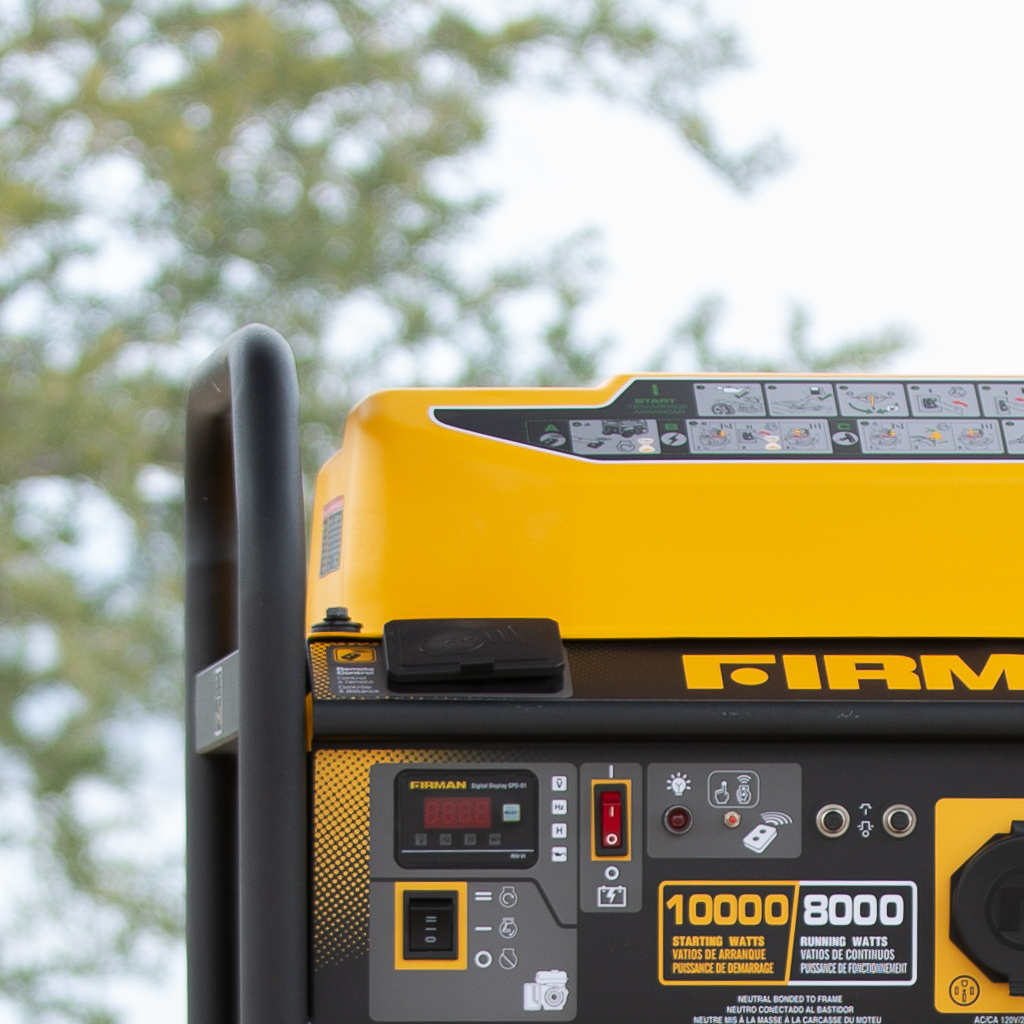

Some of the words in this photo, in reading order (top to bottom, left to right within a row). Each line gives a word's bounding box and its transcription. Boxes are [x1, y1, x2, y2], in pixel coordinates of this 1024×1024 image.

[410, 781, 466, 789] FIRMAN
[556, 826, 563, 834] H
[666, 893, 789, 925] 10000
[804, 893, 904, 926] 8000
[672, 936, 723, 947] STARTING
[729, 936, 765, 947] WATTS
[800, 936, 846, 947] RUNNING
[852, 936, 888, 947] WATTS
[672, 948, 703, 960] VATIOS
[705, 948, 717, 960] DE
[719, 948, 767, 960] ARRANQUE
[800, 948, 830, 960] VATIOS
[832, 948, 844, 960] DE
[845, 948, 895, 960] CONTINUOS
[672, 962, 714, 974] PUISSANCE
[716, 962, 727, 974] DE
[728, 962, 775, 974] DEMARRAGE
[800, 962, 836, 974] PUISSANCE
[838, 962, 847, 974] DE
[737, 995, 771, 1003] NEUTRAL
[773, 995, 804, 1003] BONDED
[806, 995, 816, 1003] TO
[817, 995, 843, 1003] FRAME
[726, 1005, 757, 1014] NEUTRO
[758, 1005, 804, 1014] CONECTADO
[806, 1005, 815, 1014] AL
[816, 1005, 854, 1014] BASTIDOR
[693, 1016, 723, 1024] NEUTRE
[746, 1016, 756, 1024] LA
[757, 1016, 782, 1024] MASSE
[791, 1016, 801, 1024] LA
[802, 1016, 842, 1024] CARCASSE
[843, 1016, 855, 1024] DU
[856, 1016, 882, 1024] MOTEU
[974, 1015, 999, 1024] AC/CA
